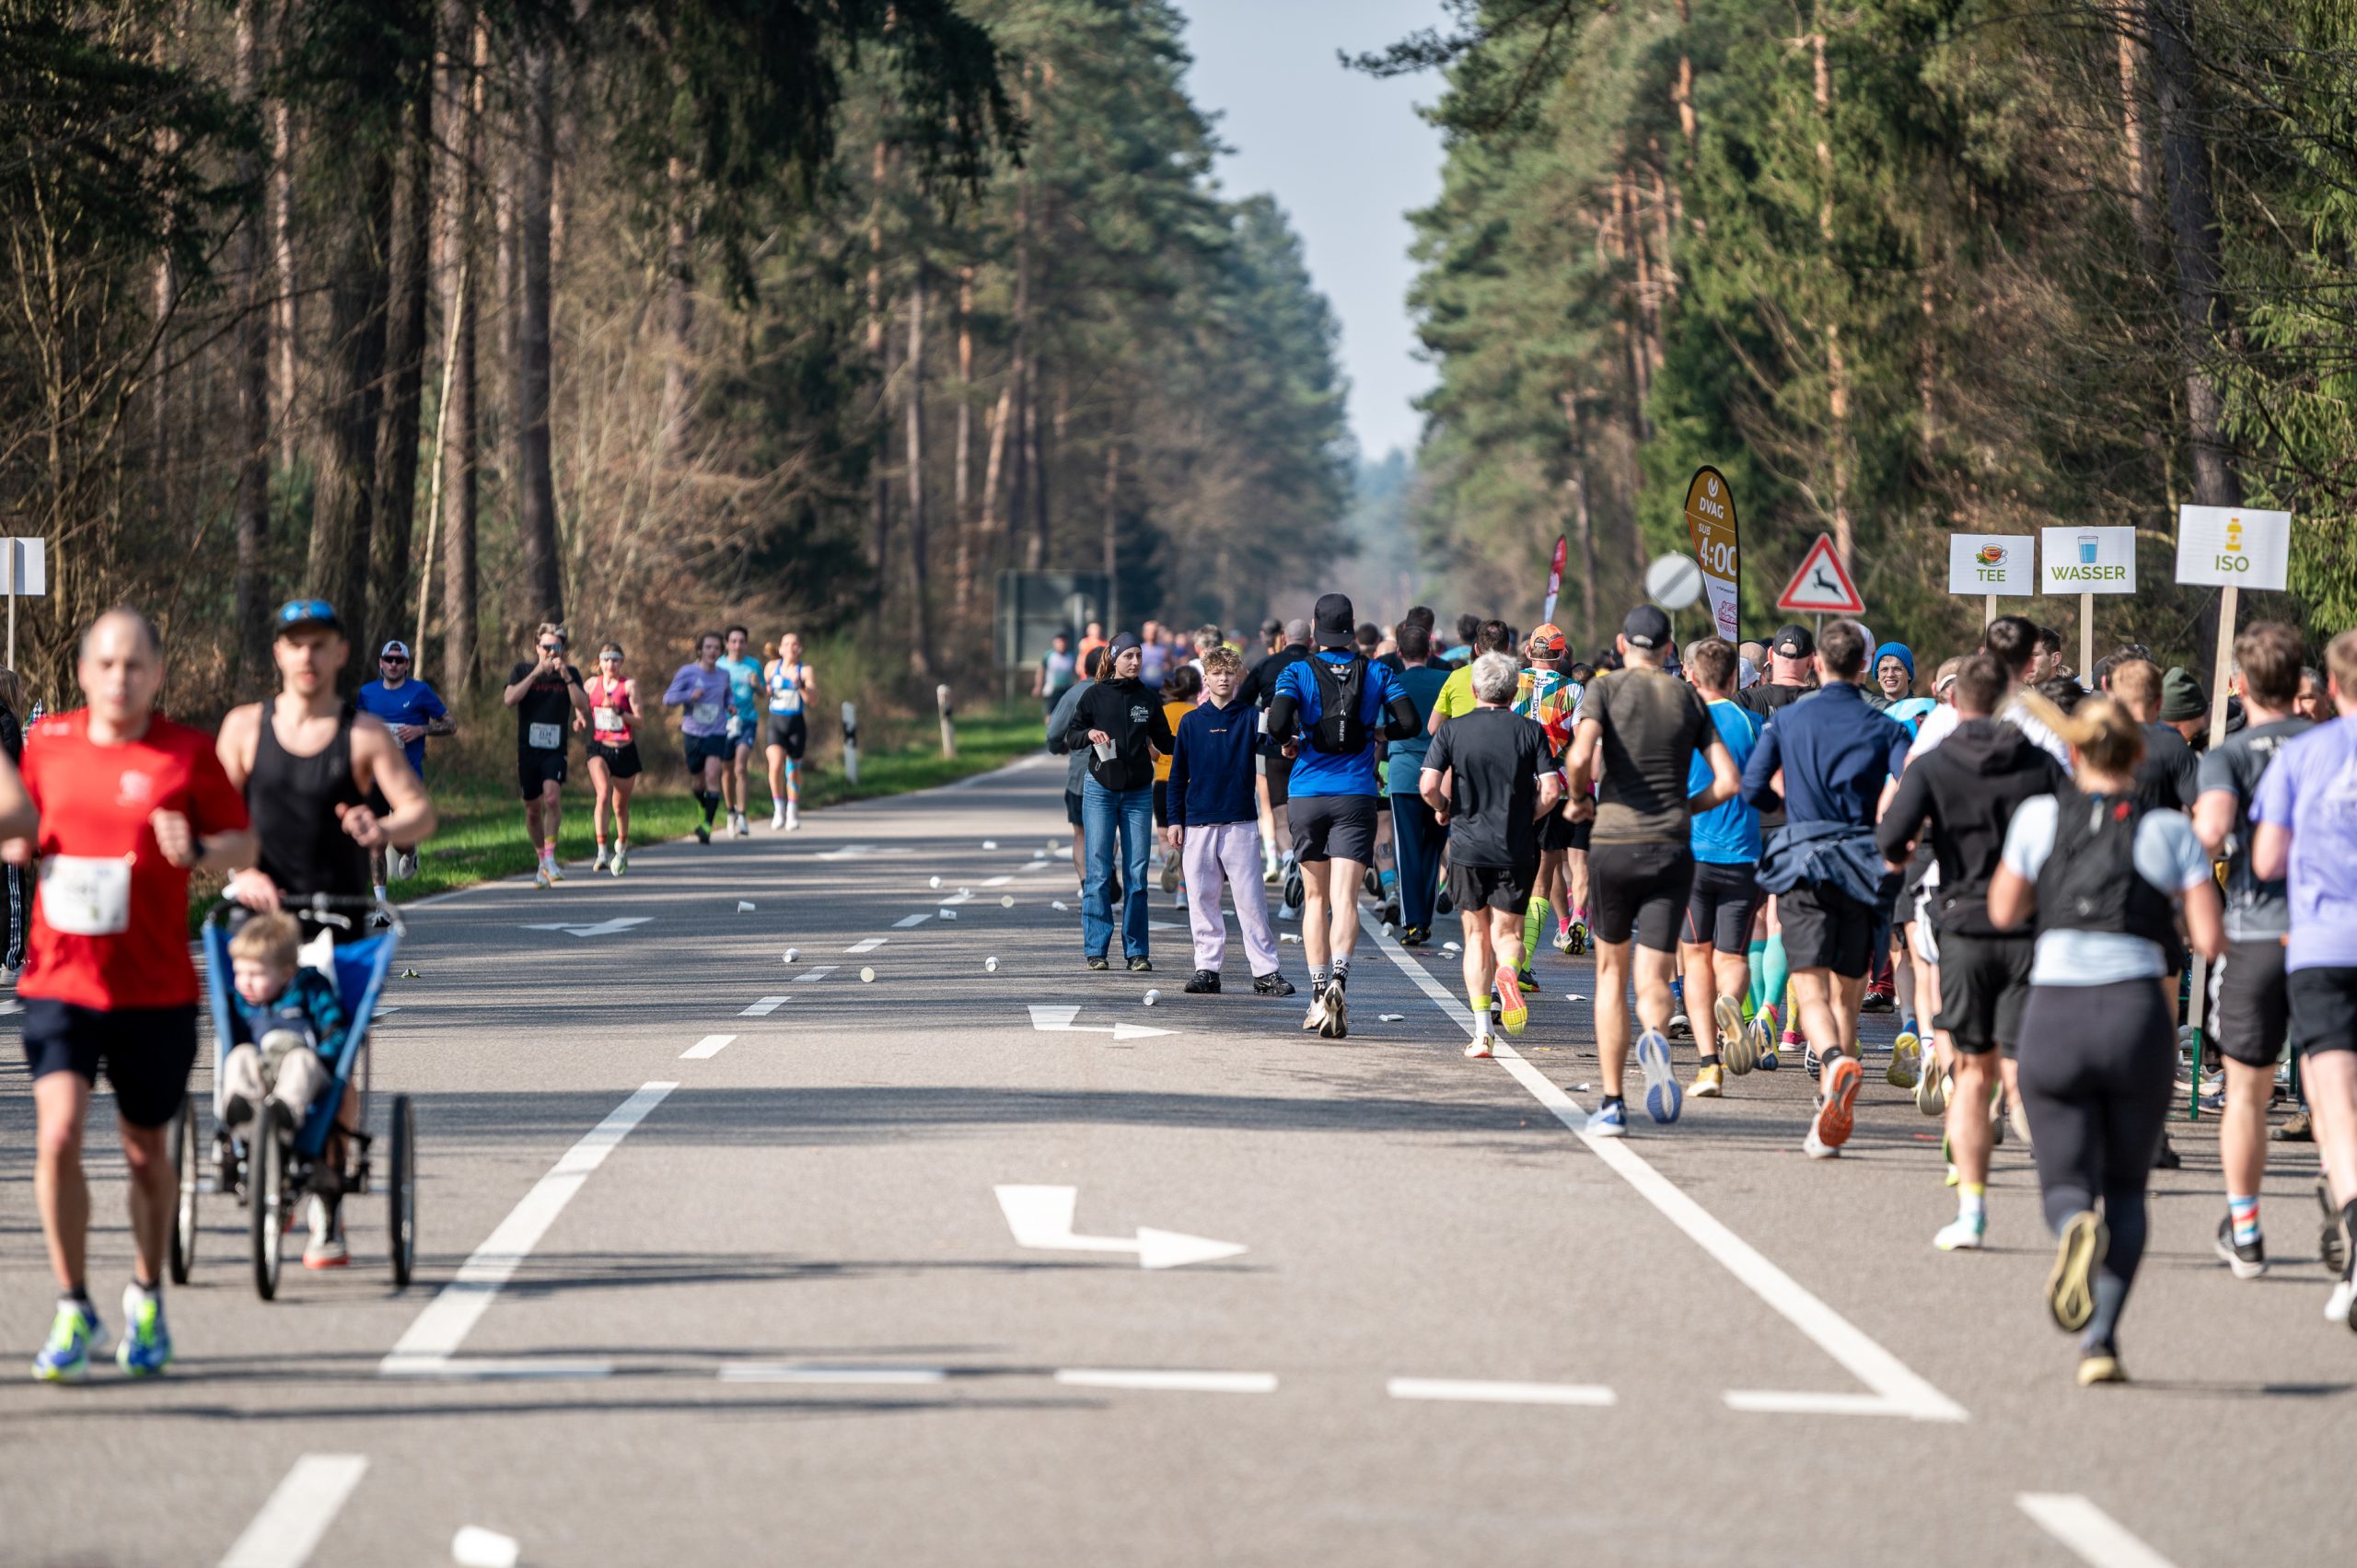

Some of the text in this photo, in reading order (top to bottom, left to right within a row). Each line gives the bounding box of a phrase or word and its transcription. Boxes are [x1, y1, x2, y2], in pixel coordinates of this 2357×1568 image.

[1700, 497, 1724, 519] DVAG
[1699, 523, 1711, 535] SUB
[2215, 554, 2249, 572] ISO
[1977, 569, 2005, 582] TEE
[2051, 565, 2126, 580] WASSER
